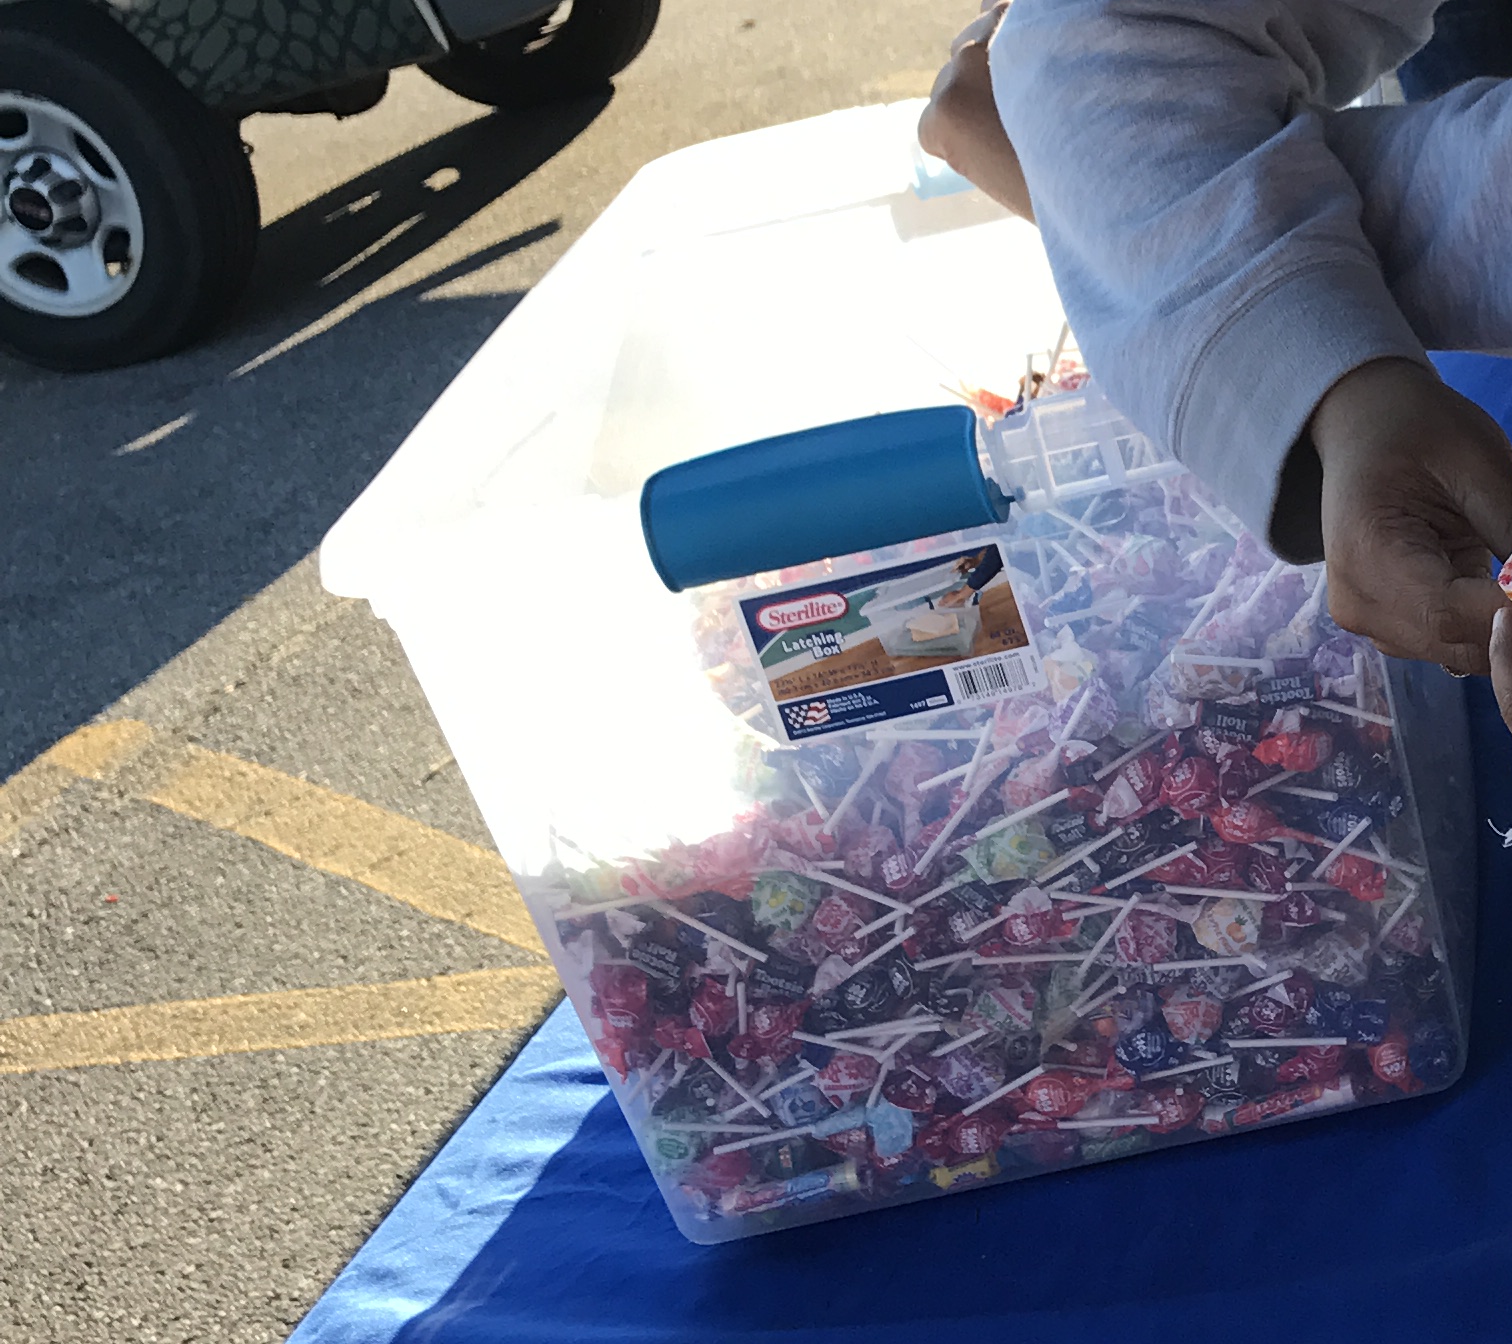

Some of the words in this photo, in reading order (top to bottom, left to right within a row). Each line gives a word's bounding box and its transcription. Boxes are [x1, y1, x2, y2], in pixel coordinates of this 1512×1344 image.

[767, 601, 838, 627] Sterilite
[782, 631, 846, 654] Latching
[813, 644, 841, 658] Box
